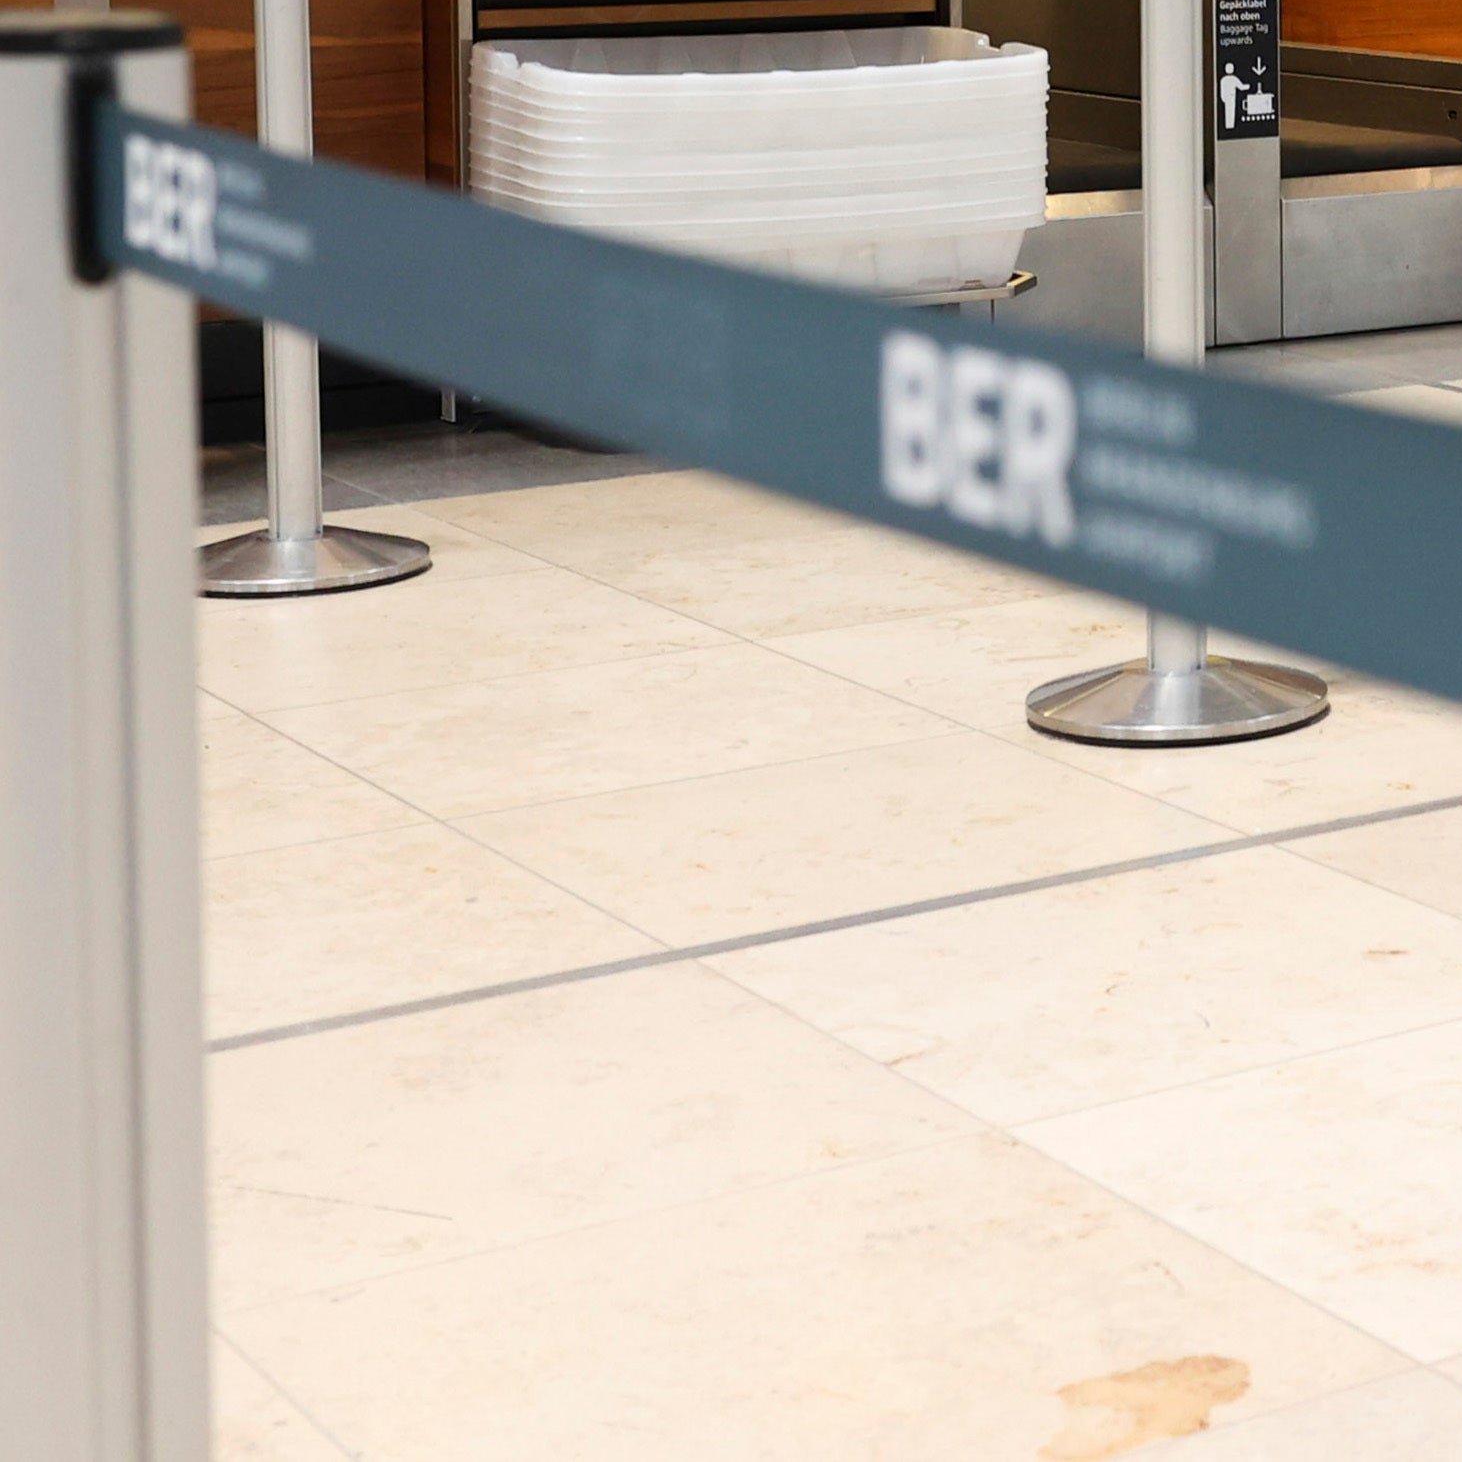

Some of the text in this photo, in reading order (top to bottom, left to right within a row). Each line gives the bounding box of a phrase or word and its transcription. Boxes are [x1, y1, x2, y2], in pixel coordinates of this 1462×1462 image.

[1220, 11, 1261, 21] nach oben
[1220, 23, 1269, 35] Baggage Tag
[1220, 36, 1253, 47] upwards
[124, 134, 218, 271] BER
[877, 330, 1078, 549] BER
